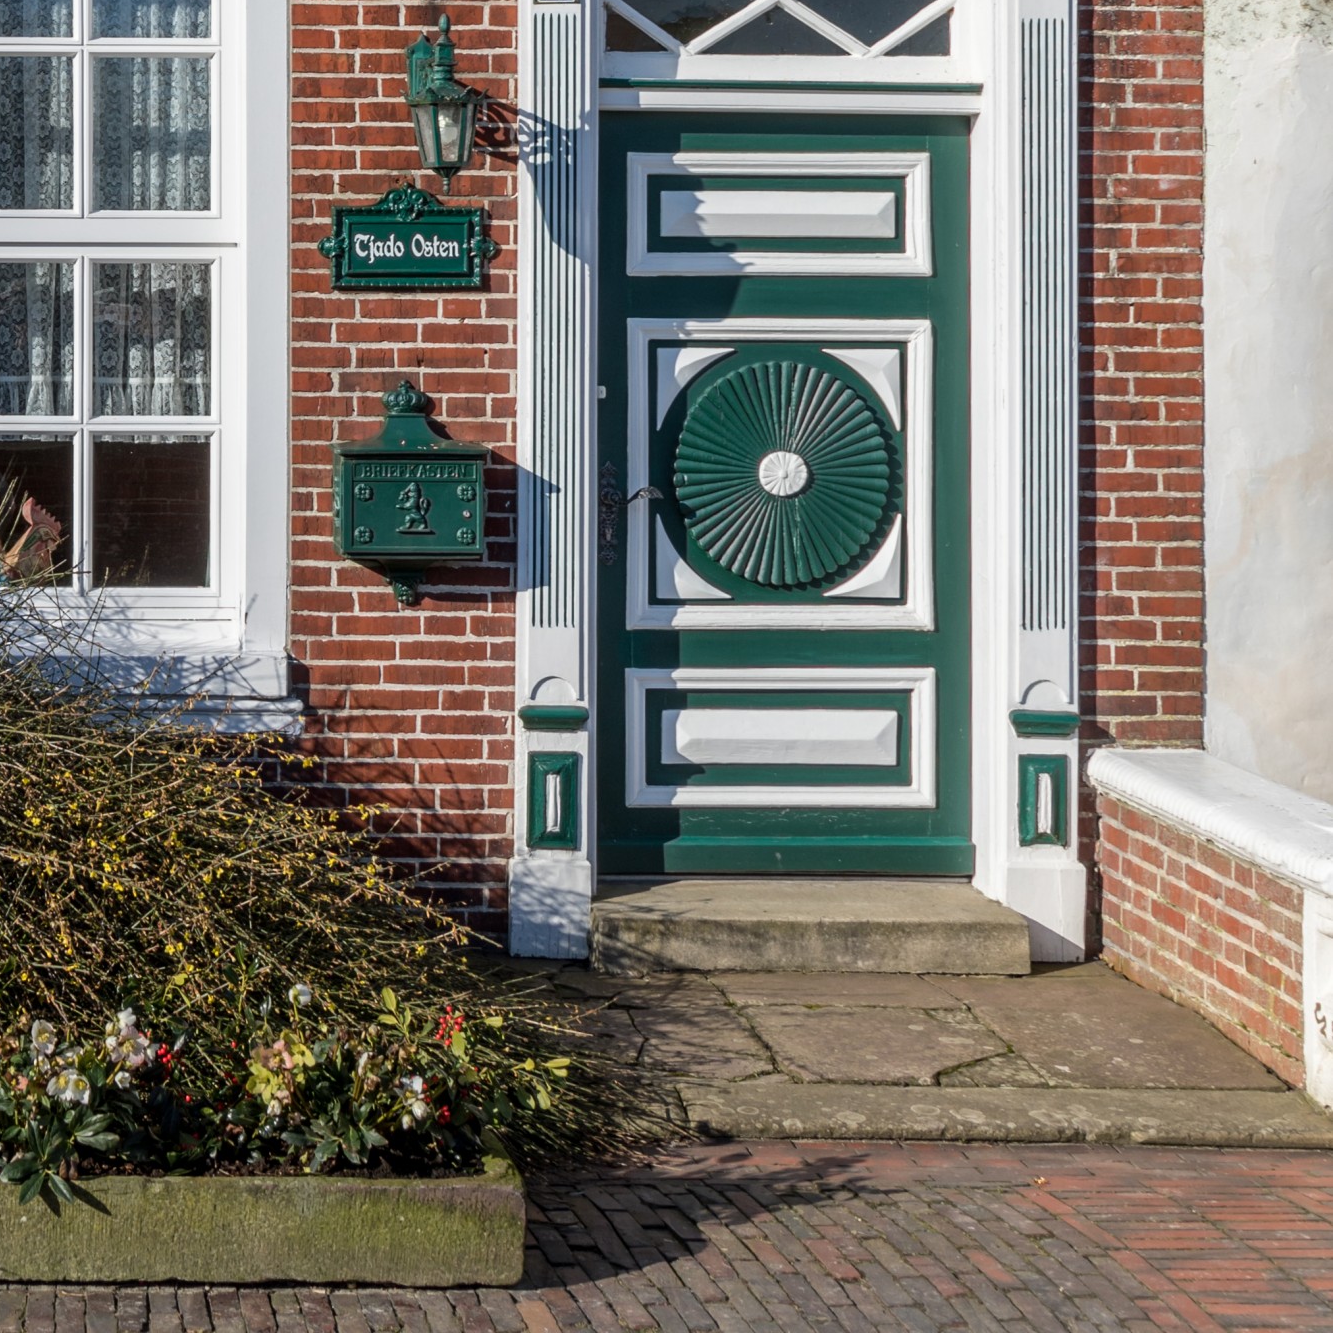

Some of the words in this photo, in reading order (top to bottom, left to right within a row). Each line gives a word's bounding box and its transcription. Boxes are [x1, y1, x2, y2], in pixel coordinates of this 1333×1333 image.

[354, 233, 405, 264] Tjado
[411, 233, 460, 258] Osten
[361, 464, 467, 478] BRIEFKASTEN
